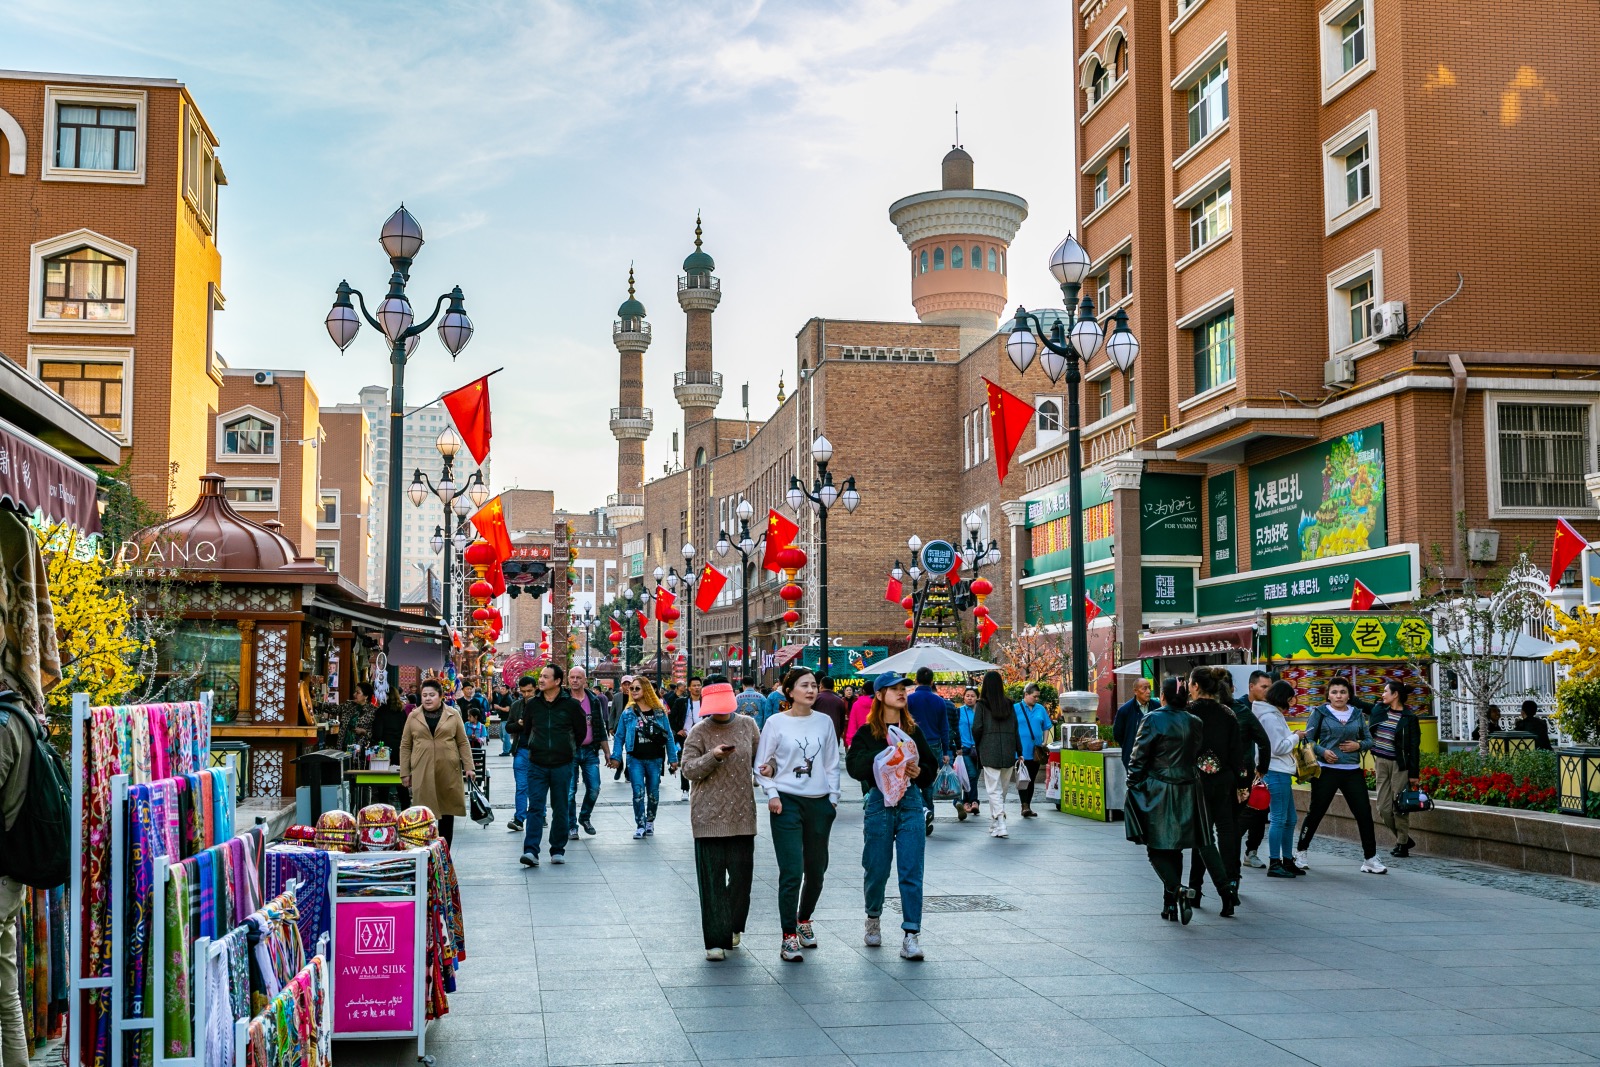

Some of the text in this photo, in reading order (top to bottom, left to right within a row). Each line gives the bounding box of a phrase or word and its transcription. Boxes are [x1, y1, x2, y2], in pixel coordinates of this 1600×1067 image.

[1254, 472, 1303, 511] 水果巴扎
[1256, 521, 1289, 546] 只为好吃
[1291, 577, 1320, 597] 水果巴扎
[1310, 622, 1426, 648] 疆老爷
[342, 964, 407, 975] AWAM SILK
